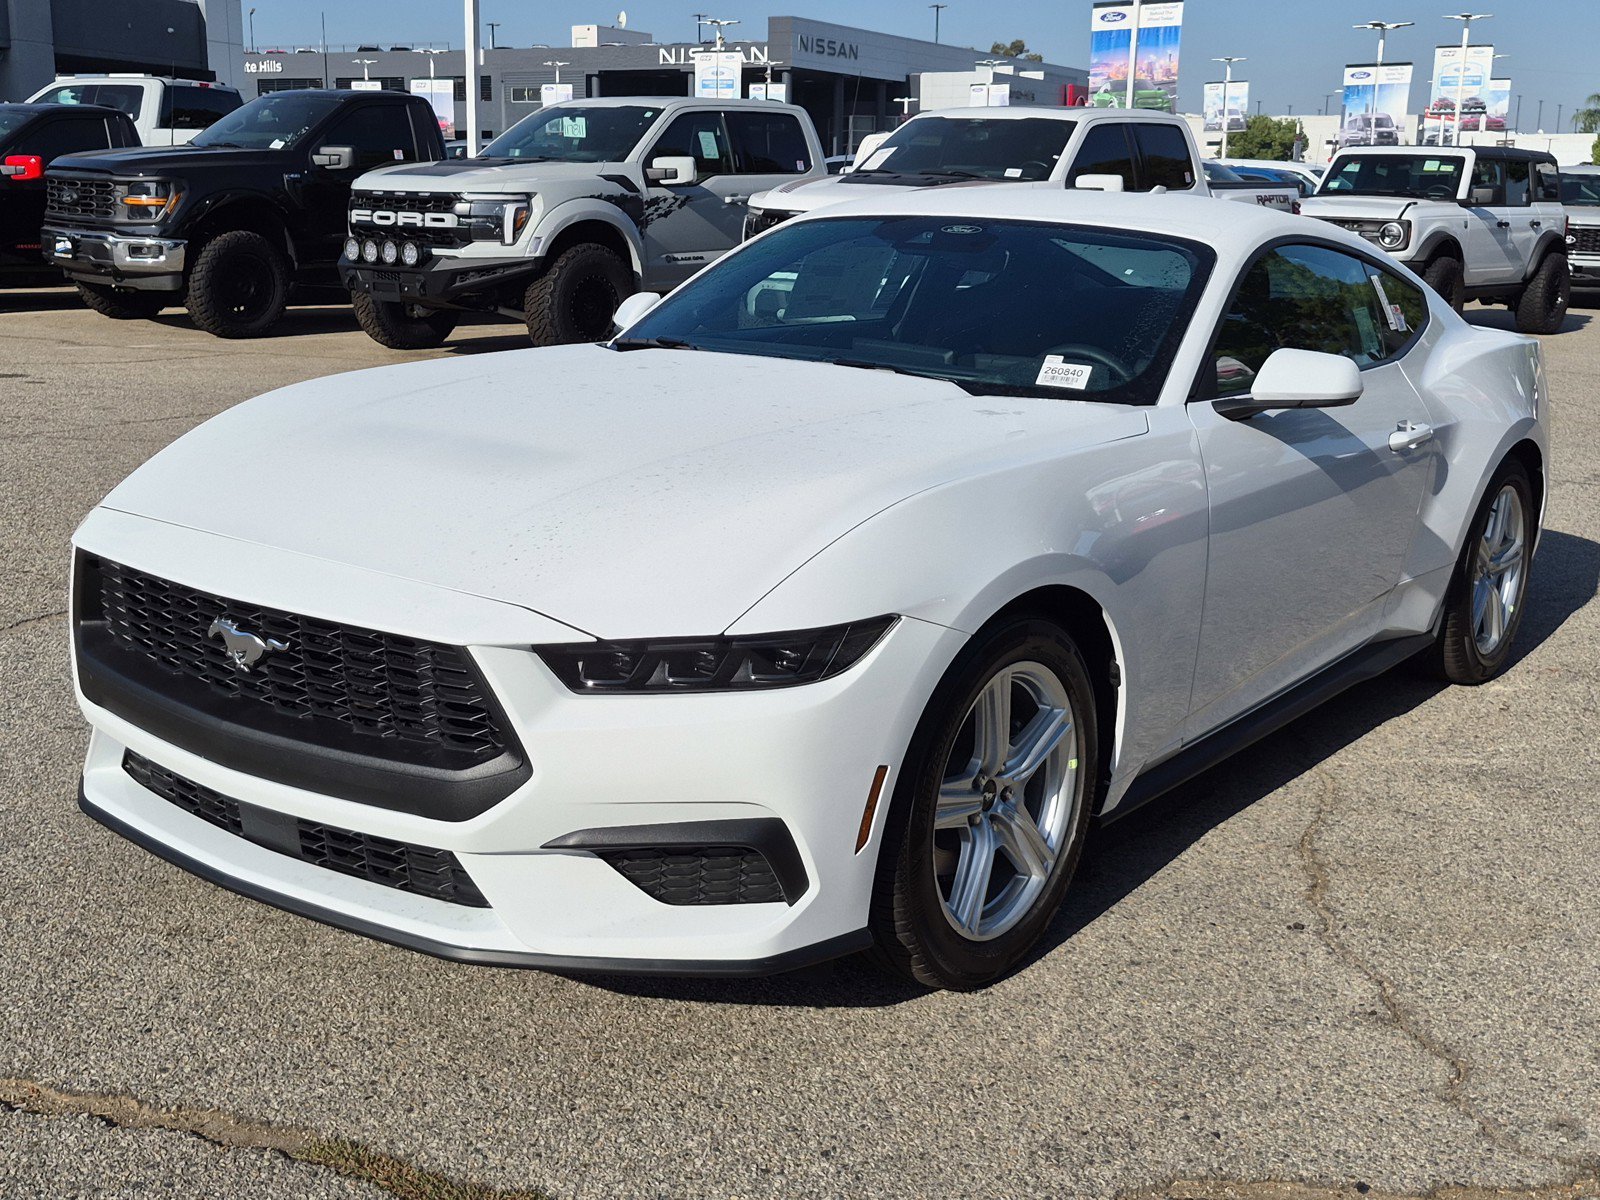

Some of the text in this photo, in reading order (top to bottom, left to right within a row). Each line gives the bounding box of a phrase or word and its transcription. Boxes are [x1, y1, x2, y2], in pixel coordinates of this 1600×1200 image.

[798, 34, 859, 60] NISSAN
[259, 60, 283, 73] Hills
[1256, 194, 1290, 206] RAPTOR
[351, 209, 459, 228] FORD
[1044, 366, 1084, 378] 260840
